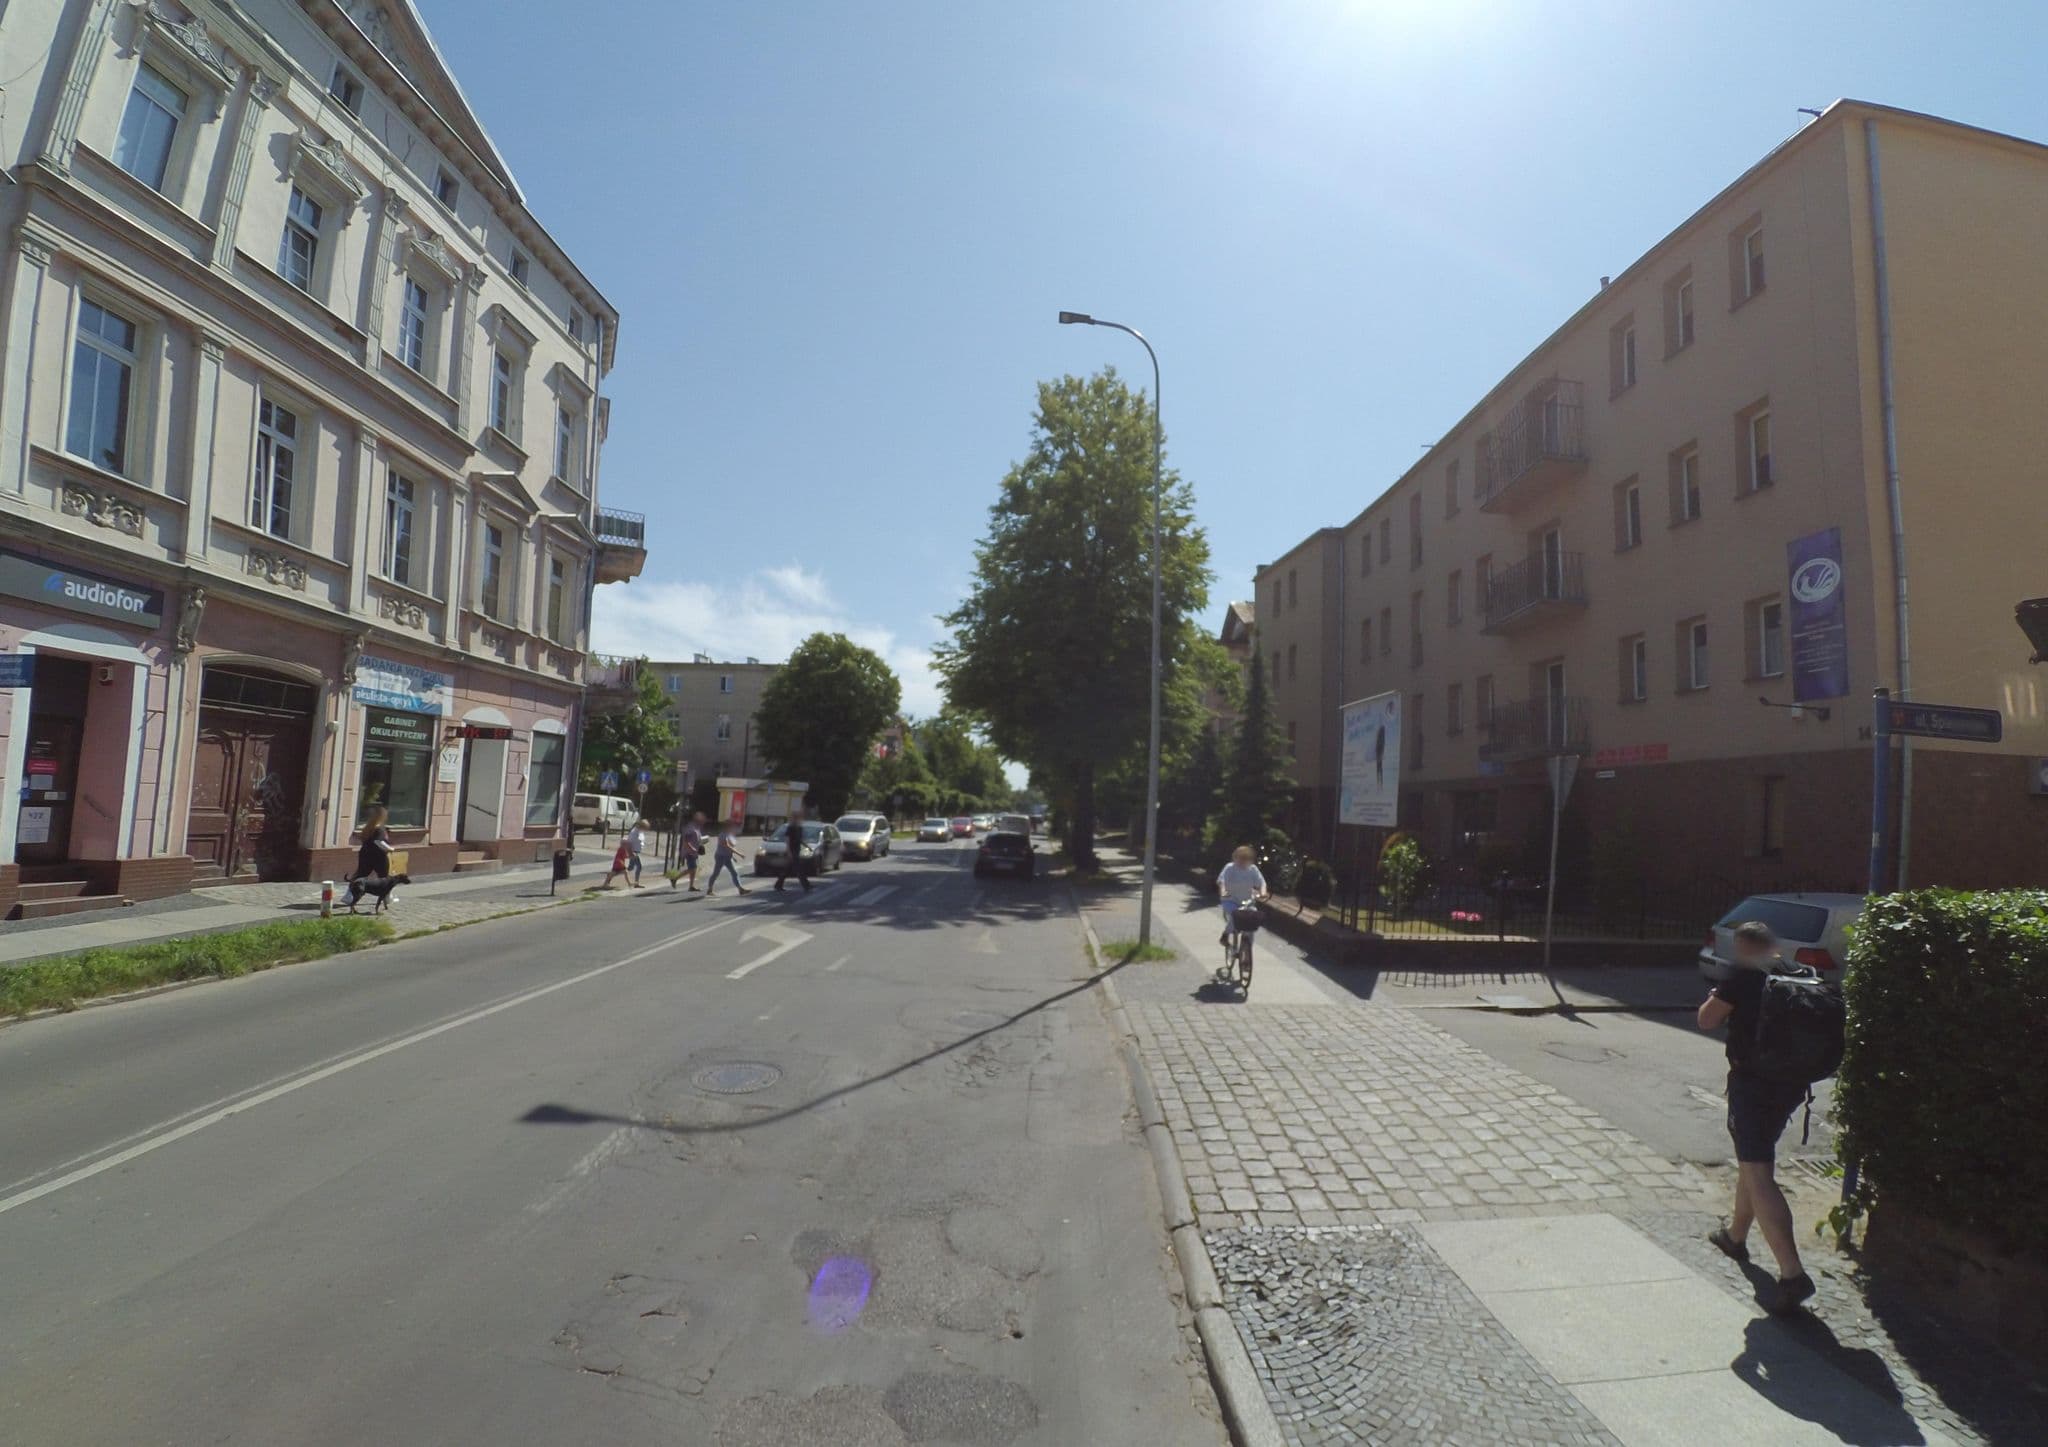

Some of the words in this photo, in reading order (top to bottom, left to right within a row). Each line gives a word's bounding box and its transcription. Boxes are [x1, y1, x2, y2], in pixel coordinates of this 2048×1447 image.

[64, 581, 144, 613] audiofon
[384, 716, 417, 727] GABINET
[370, 726, 428, 740] OKULISTYCZNY
